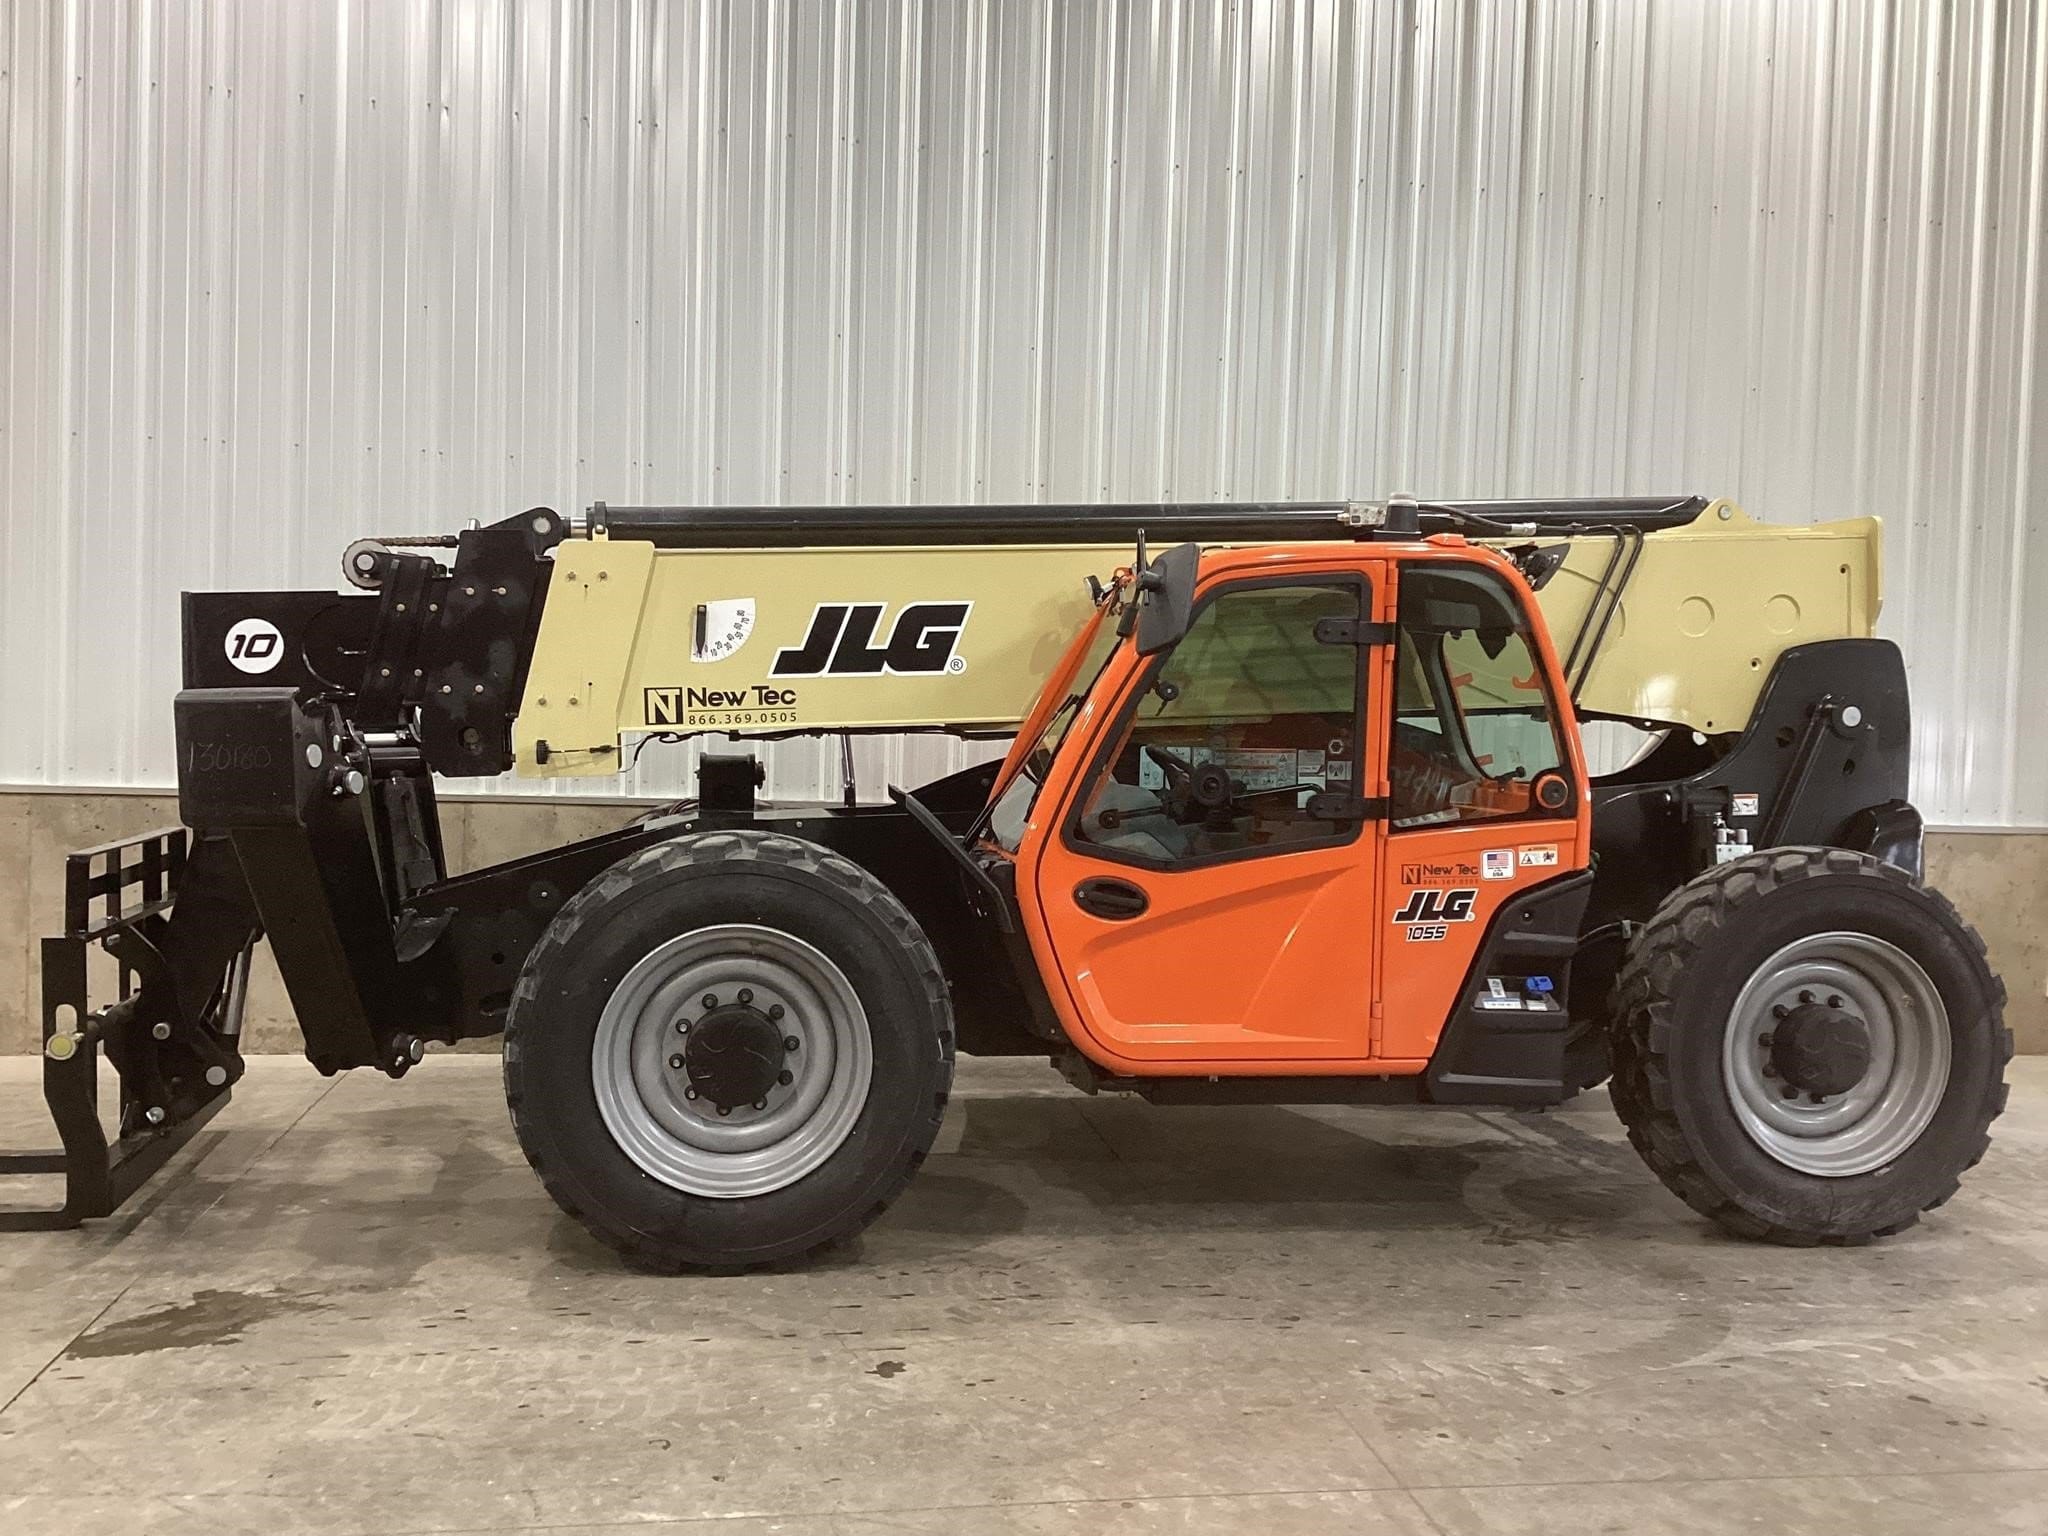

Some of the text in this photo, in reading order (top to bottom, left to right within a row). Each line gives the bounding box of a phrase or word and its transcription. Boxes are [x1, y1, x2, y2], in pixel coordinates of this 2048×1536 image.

[231, 633, 278, 659] 10
[715, 640, 723, 650] 20
[769, 602, 973, 677] JLG
[687, 685, 796, 707] New Tec
[688, 712, 797, 725] 866.369.0505
[1423, 864, 1478, 875] New Tec
[1394, 890, 1477, 922] JLG
[1407, 926, 1447, 941] 1055
